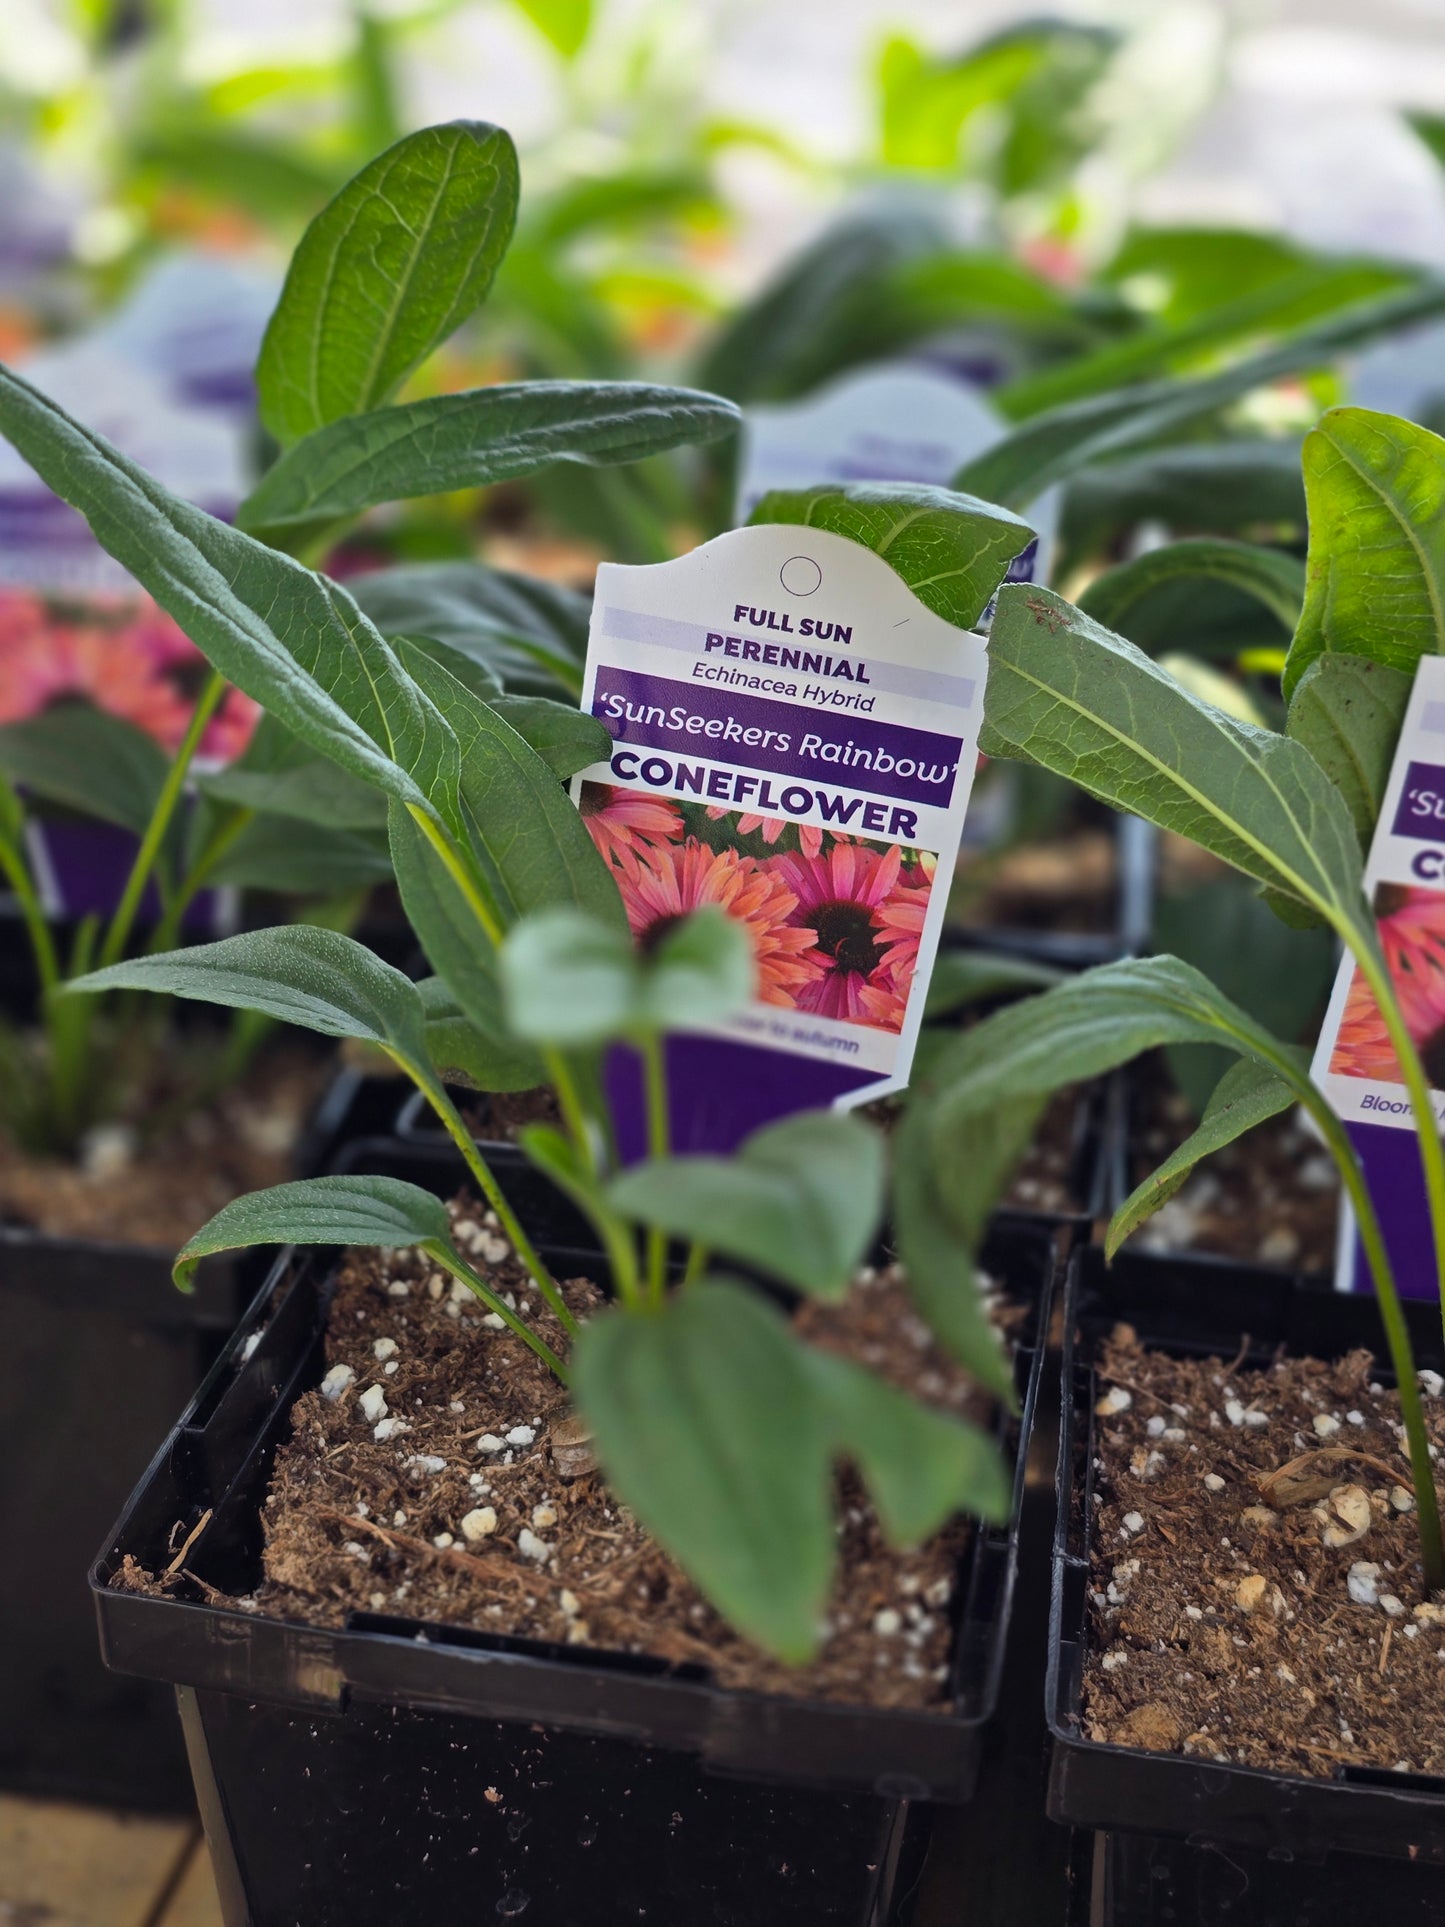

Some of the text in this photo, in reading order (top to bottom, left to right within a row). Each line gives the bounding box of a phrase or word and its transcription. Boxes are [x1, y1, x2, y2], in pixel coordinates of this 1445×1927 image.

[733, 604, 853, 644] FULL SUN
[704, 632, 871, 684] PERENNIAL
[692, 662, 876, 713] Echinacea Hybrid
[610, 751, 918, 839] CONEFLOWER
